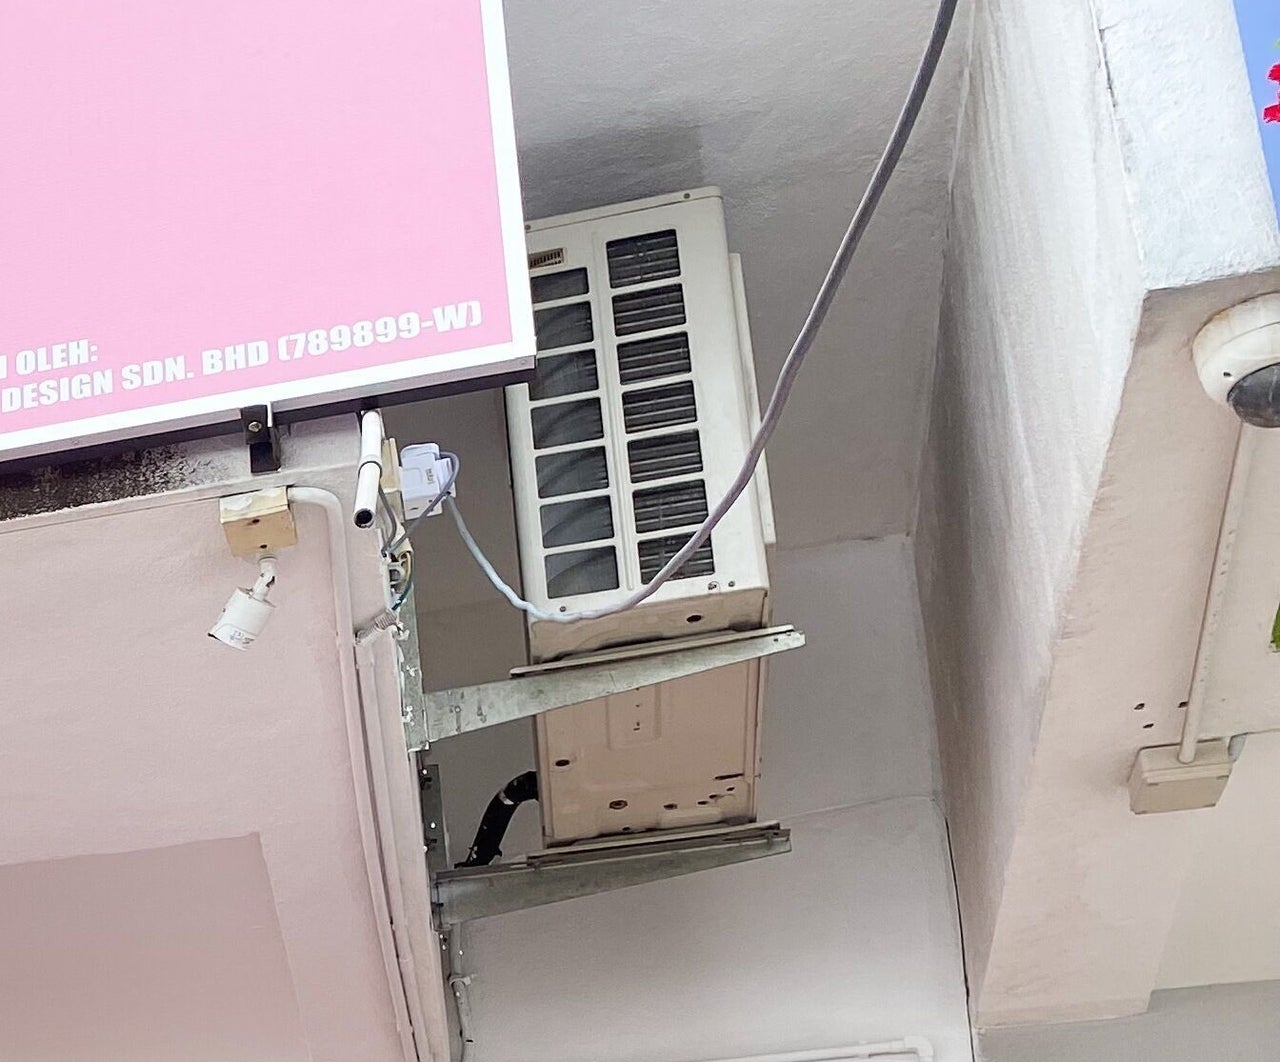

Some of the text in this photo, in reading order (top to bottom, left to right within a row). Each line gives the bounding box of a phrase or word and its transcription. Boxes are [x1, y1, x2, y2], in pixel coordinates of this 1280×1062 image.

[1, 375, 113, 415] DESIGN
[120, 357, 195, 392] SDN.
[202, 339, 269, 375] BHD
[276, 299, 484, 363] (789899-W)
[15, 338, 99, 374] OLEH:
